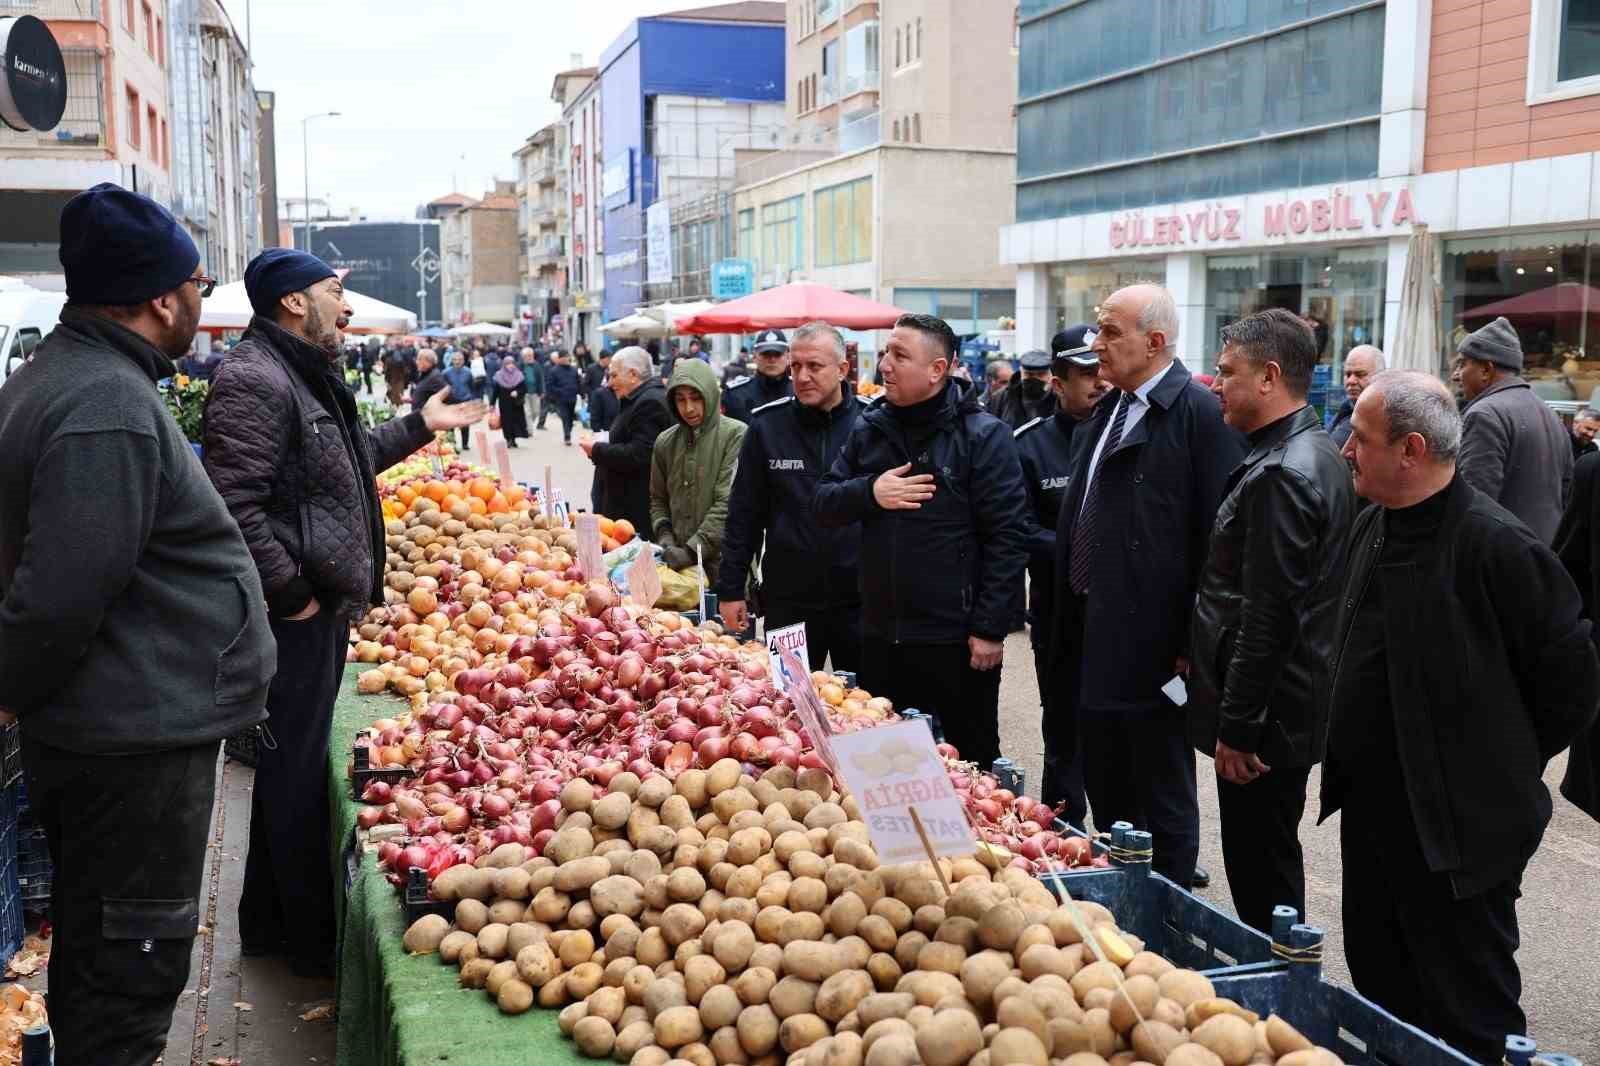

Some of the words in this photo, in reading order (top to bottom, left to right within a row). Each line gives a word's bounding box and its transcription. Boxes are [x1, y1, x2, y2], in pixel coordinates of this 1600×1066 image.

[1110, 204, 1241, 249] GÜLERYÜZ
[1264, 187, 1416, 237] MOBİLYA
[768, 458, 805, 470] ZABITA
